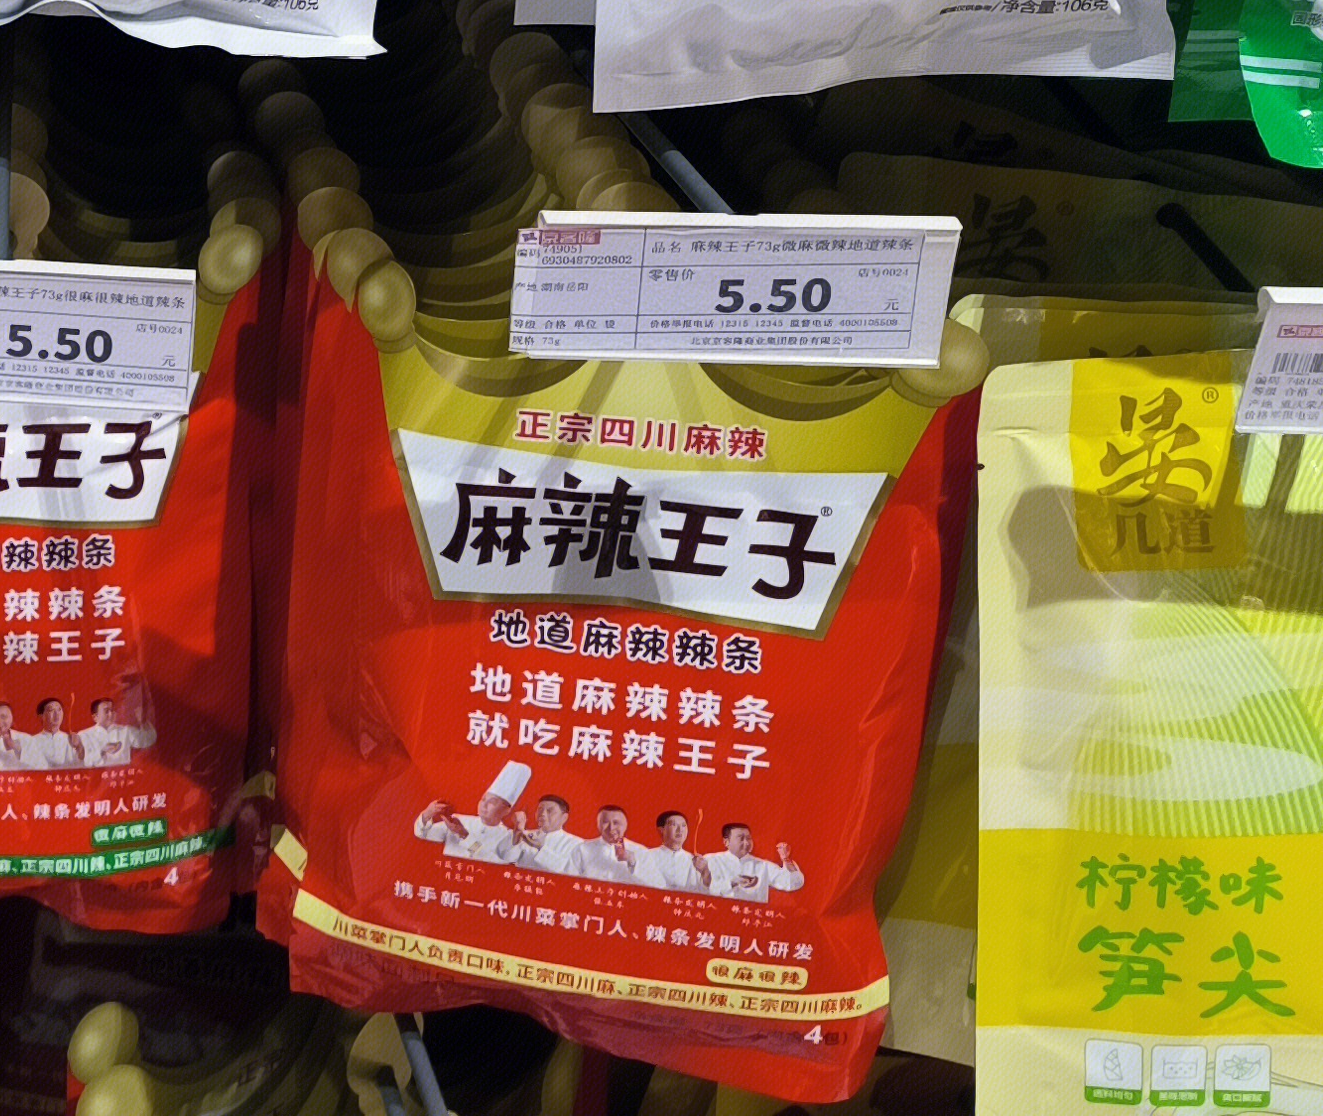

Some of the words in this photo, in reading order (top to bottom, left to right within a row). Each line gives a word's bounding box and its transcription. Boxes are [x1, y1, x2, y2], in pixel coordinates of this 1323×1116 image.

[648, 267, 695, 283] 零售价
[714, 277, 832, 314] 5.50
[884, 297, 900, 312] 元
[5, 323, 113, 364] 5.50
[162, 354, 176, 367] 元
[514, 410, 767, 460] 正宗四川麻辣
[440, 467, 837, 600] 麻辣王子
[490, 609, 762, 672] 地道麻辣辣条
[469, 662, 775, 734] 地道麻辣辣条
[466, 710, 771, 780] 就吃麻辣王子
[1076, 852, 1284, 916] 柠檬味
[1077, 923, 1297, 1018] 笋尖
